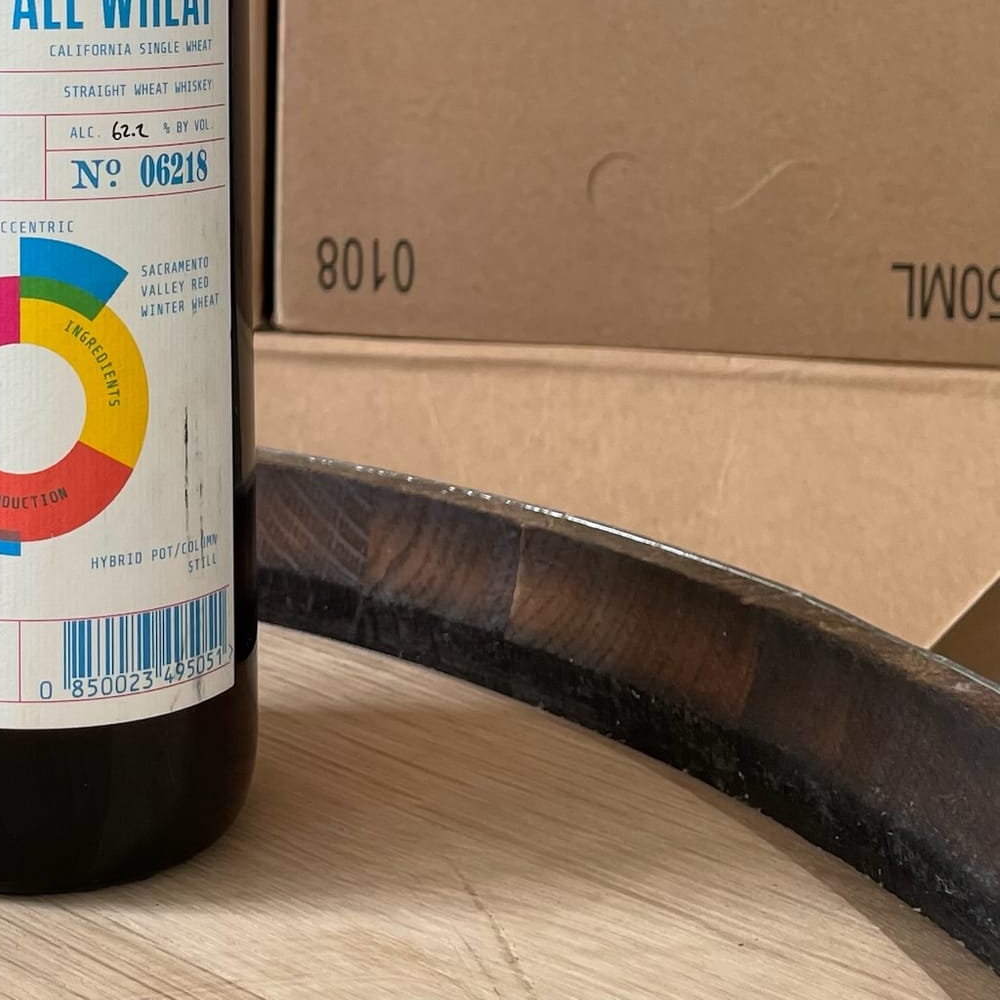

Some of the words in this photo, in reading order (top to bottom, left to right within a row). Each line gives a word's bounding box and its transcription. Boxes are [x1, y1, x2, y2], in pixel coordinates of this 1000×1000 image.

[50, 43, 131, 57] CALIFORNIA
[140, 41, 180, 55] SINGLE
[185, 39, 212, 52] WHEAT
[64, 84, 126, 98] STRAIGHT
[134, 82, 168, 96] WHEAT
[175, 79, 212, 94] WHISKEY
[176, 120, 189, 134] BY
[140, 149, 208, 187] 06218
[141, 256, 209, 277] SACRAMENTO
[317, 236, 415, 293] 0108
[141, 280, 185, 297] VALLEY
[191, 276, 209, 289] RED
[141, 299, 185, 317] WINTER
[191, 293, 219, 312] WHEAT
[64, 319, 121, 407] INGREDIENTS
[91, 551, 142, 569] HYBRID
[151, 533, 218, 561] POT/COLUMN
[187, 553, 217, 574] STILL
[40, 680, 53, 700] 0
[72, 671, 154, 698] 850023
